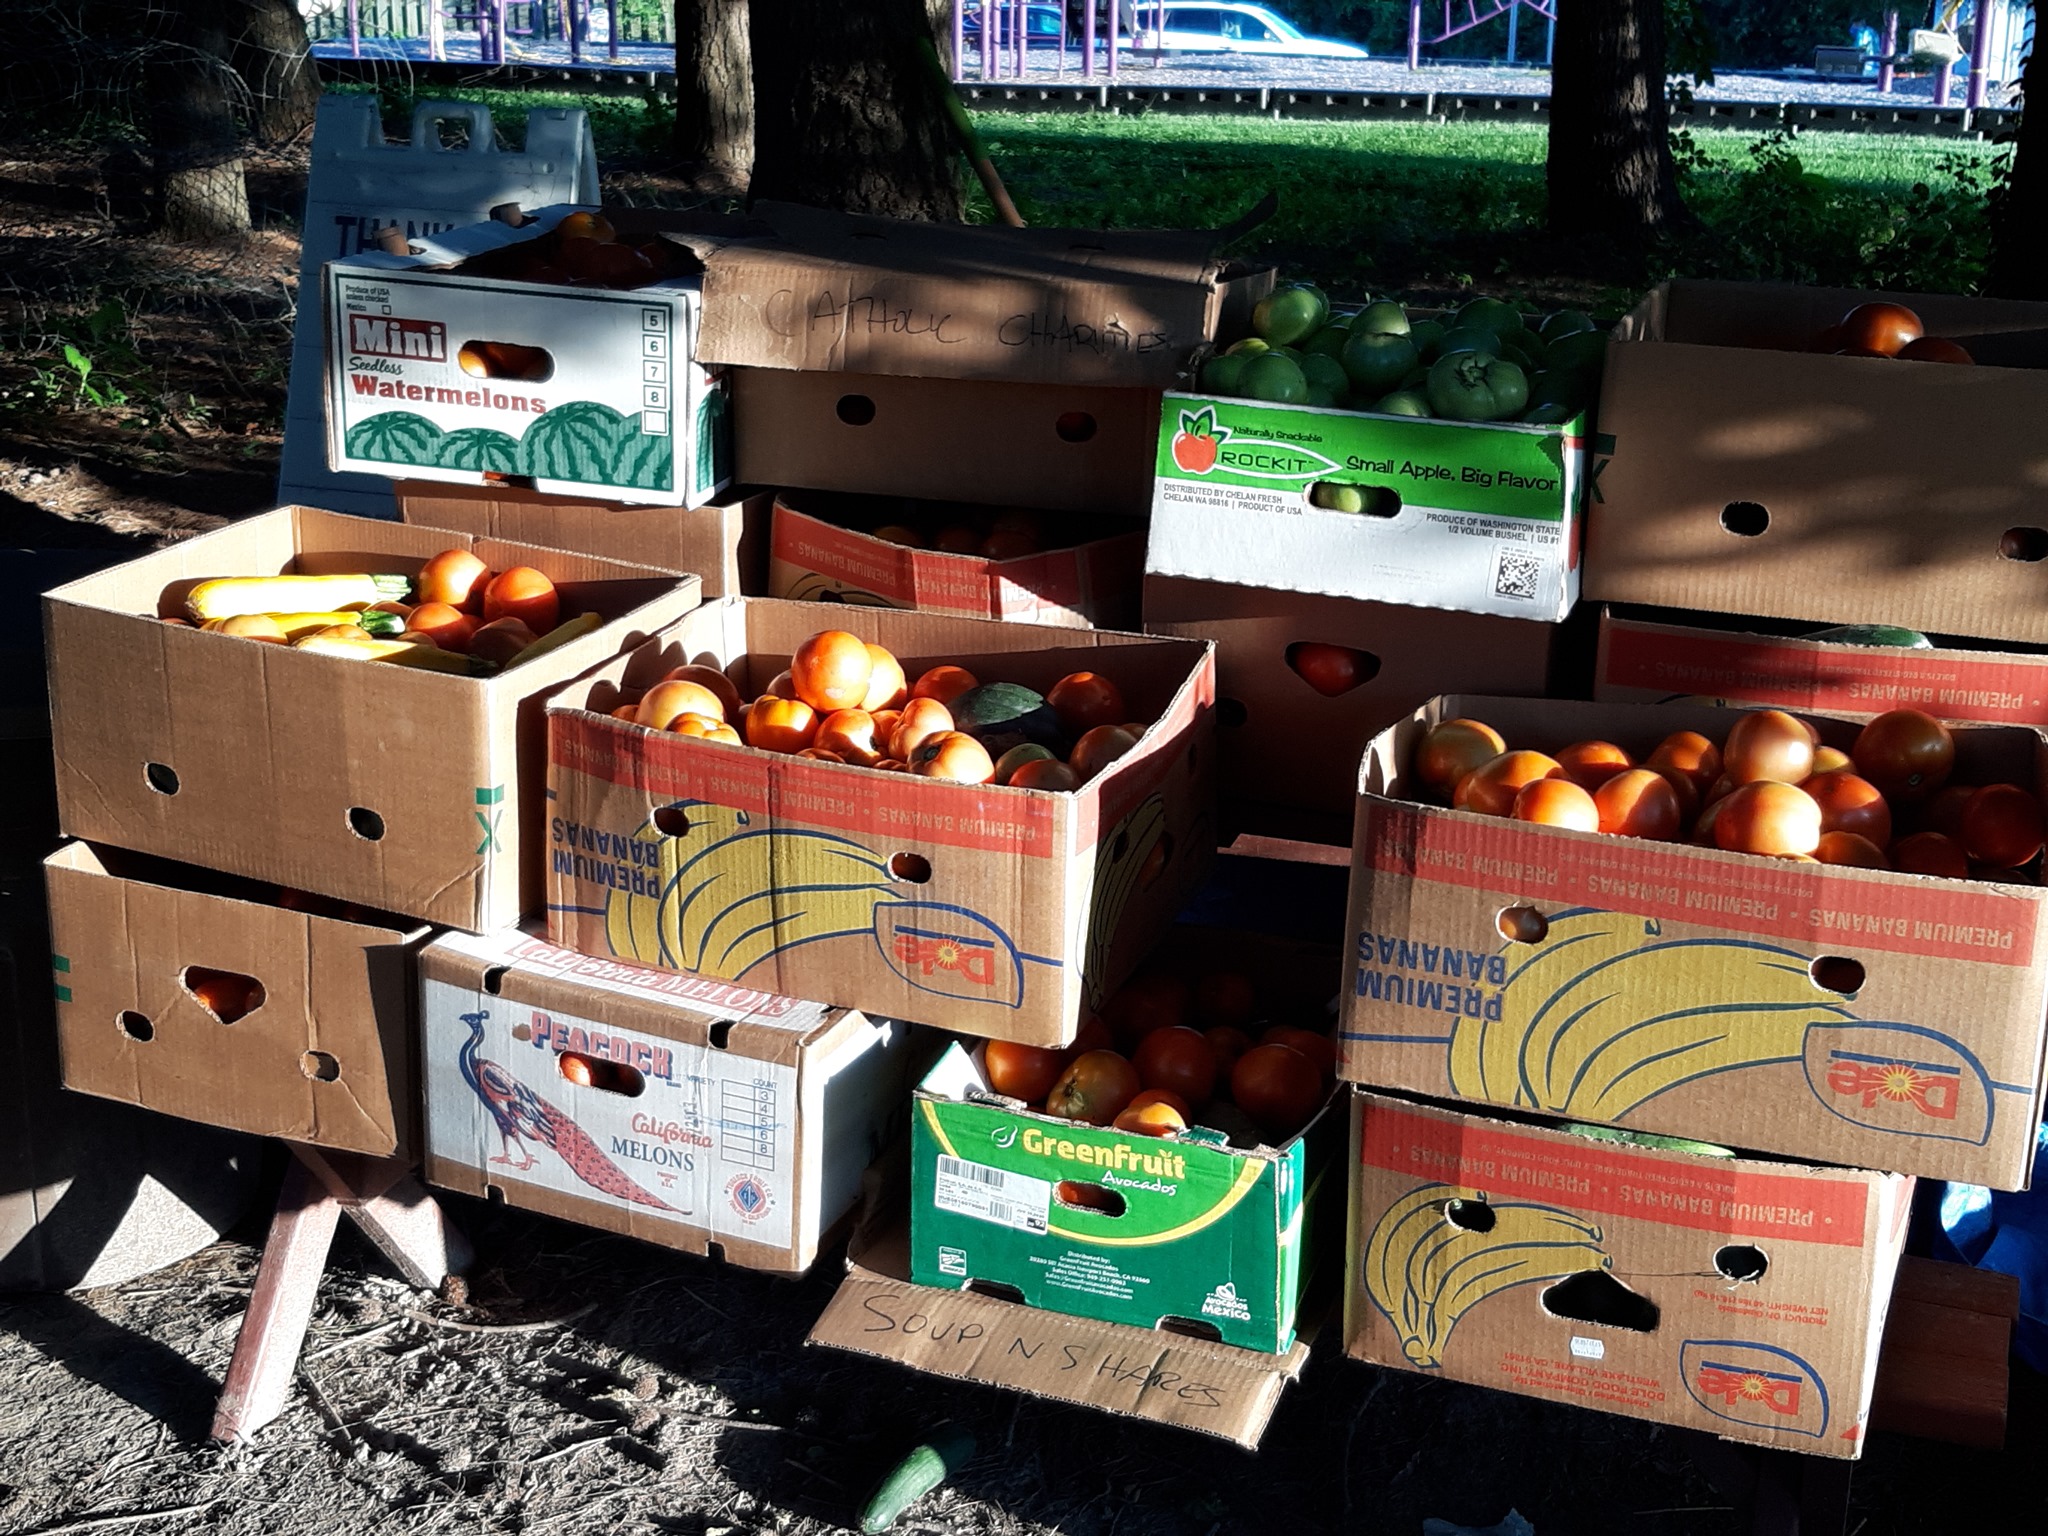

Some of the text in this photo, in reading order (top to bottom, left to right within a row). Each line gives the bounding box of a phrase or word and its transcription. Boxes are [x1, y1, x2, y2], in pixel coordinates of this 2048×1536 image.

[346, 284, 391, 296] Produce of USA
[649, 315, 659, 327] 5
[353, 317, 445, 360] Mini
[649, 340, 659, 352] 6
[347, 356, 404, 375] Seedless
[649, 365, 659, 377] 7
[351, 373, 547, 414] Watermelons
[650, 390, 660, 403] 8
[1233, 426, 1322, 443] Naturally Snackable
[1221, 451, 1307, 472] ROCKIT
[1346, 455, 1394, 474] Small
[1461, 467, 1493, 488] Big
[1497, 471, 1559, 491] Flavor
[1163, 483, 1282, 504] DISTRIBUTED BY CHELAN FRESH
[1163, 493, 1303, 516] CHELAN WA 98816 PRODUCT OF USA
[1426, 513, 1560, 536] PRODUCE OF WASHINGTON STATE
[1447, 525, 1459, 535] 1/2
[1460, 525, 1494, 538] VOLUME
[1494, 529, 1528, 542] BUSHEL
[1537, 534, 1549, 545] US
[1848, 682, 2025, 710] PREMIUM BANANAS
[880, 806, 953, 831] BANANAS
[553, 818, 659, 869] BANANAS
[553, 848, 661, 899] PREMIUM
[1472, 855, 1559, 886] PREMIUM
[1588, 875, 1780, 920] PREMIUM BANANAS
[1809, 909, 2014, 950] PREMIUM BANANAS
[894, 935, 995, 986] Dole
[1358, 932, 1506, 984] BANANAS
[512, 940, 793, 1017] California MELONS
[1356, 967, 1503, 1021] PREMIUM
[530, 1011, 673, 1080] PEACOCK
[752, 1078, 778, 1090] COUNT
[1827, 1061, 1961, 1120] Dole
[760, 1091, 769, 1101] 3
[760, 1104, 768, 1114] 4
[631, 1112, 715, 1149] California
[760, 1117, 768, 1127] 5
[760, 1130, 768, 1141] 6
[611, 1135, 695, 1173] MELONS
[760, 1143, 768, 1154] 8
[1022, 1128, 1187, 1179] GreenFruit
[1411, 1146, 1591, 1195] PREMIUM BANANAS
[1101, 1170, 1178, 1196] Avocados
[1619, 1185, 1814, 1228] PREMIUM BANANAS
[1067, 1250, 1101, 1261] Distributed
[1201, 1303, 1251, 1320] Mexico
[1204, 1296, 1248, 1311] Avocados
[1767, 1302, 1809, 1314] WEIGHT:
[1810, 1306, 1829, 1316] NET
[863, 1294, 985, 1345] SOUP
[1008, 1337, 1046, 1360] N
[1783, 1313, 1828, 1326] PRODUCT
[1533, 1357, 1549, 1368] CA
[1592, 1381, 1628, 1395] FOOD
[1601, 1370, 1661, 1388] WESTLAKE
[1629, 1387, 1666, 1402] DOLE
[1697, 1368, 1801, 1416] Dole
